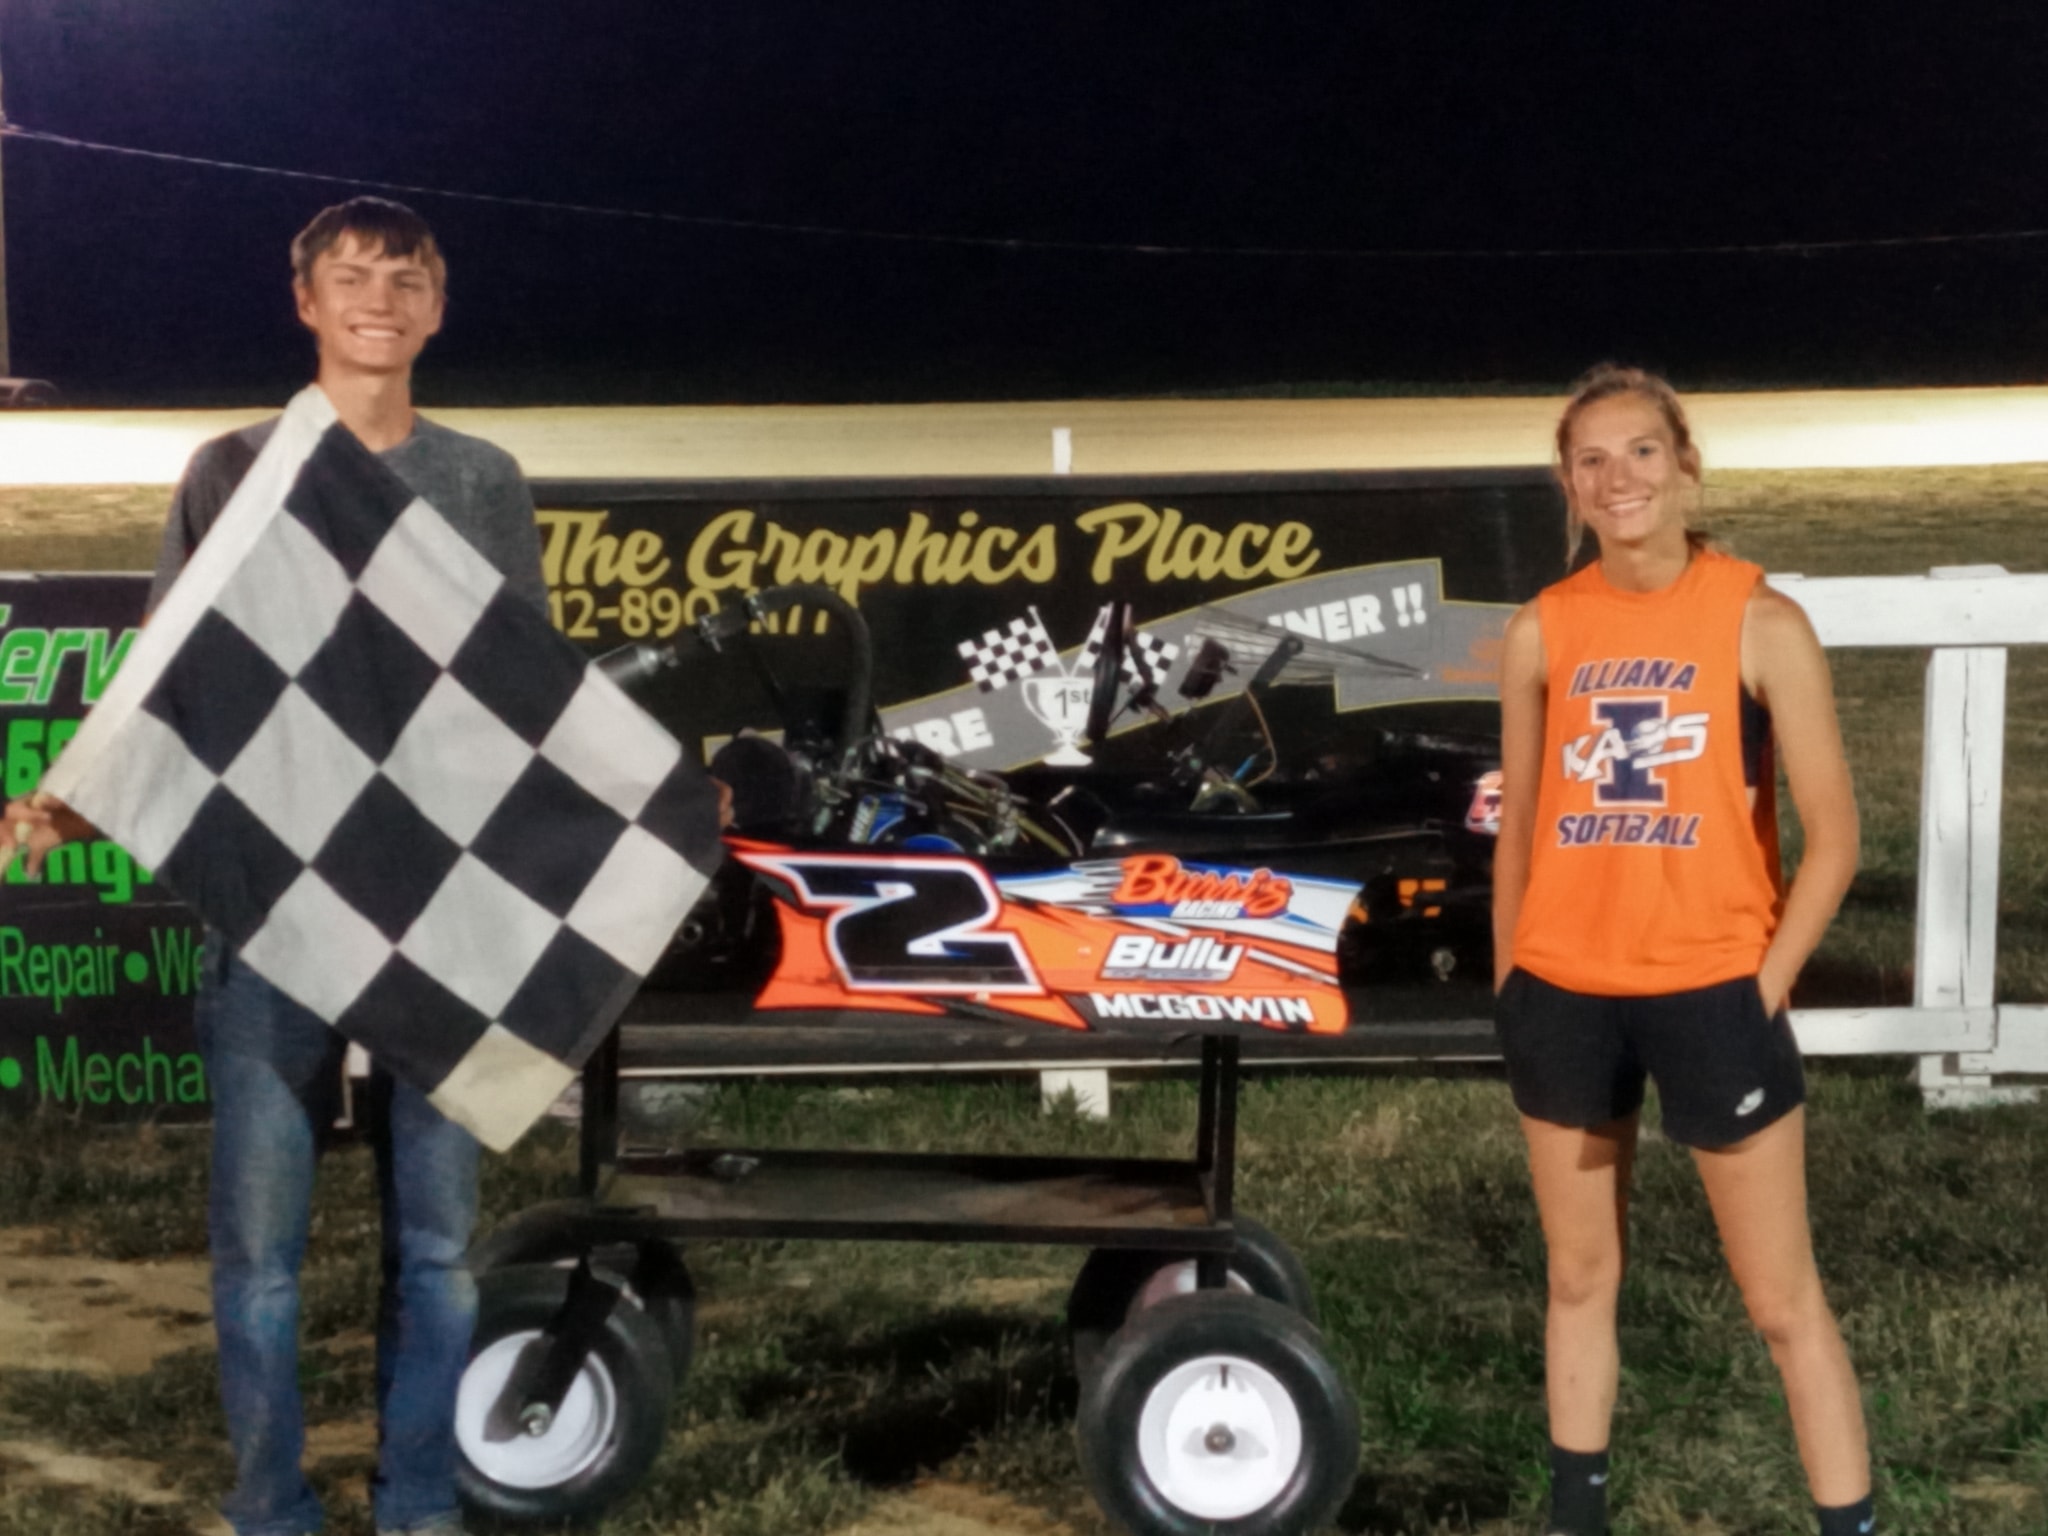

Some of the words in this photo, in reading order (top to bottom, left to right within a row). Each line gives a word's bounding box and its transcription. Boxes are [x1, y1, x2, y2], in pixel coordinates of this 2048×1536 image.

[534, 509, 671, 587] The
[686, 509, 1056, 609] Graphics
[1075, 502, 1321, 584] Place
[1569, 658, 1698, 697] ILLIANA
[1557, 811, 1703, 848] SOFTBALL
[732, 853, 1046, 996] 2
[0, 925, 119, 1014] Repair
[1103, 934, 1244, 980] Bully
[1090, 992, 1315, 1024] MCGOWIN
[35, 1035, 208, 1104] Mecha
